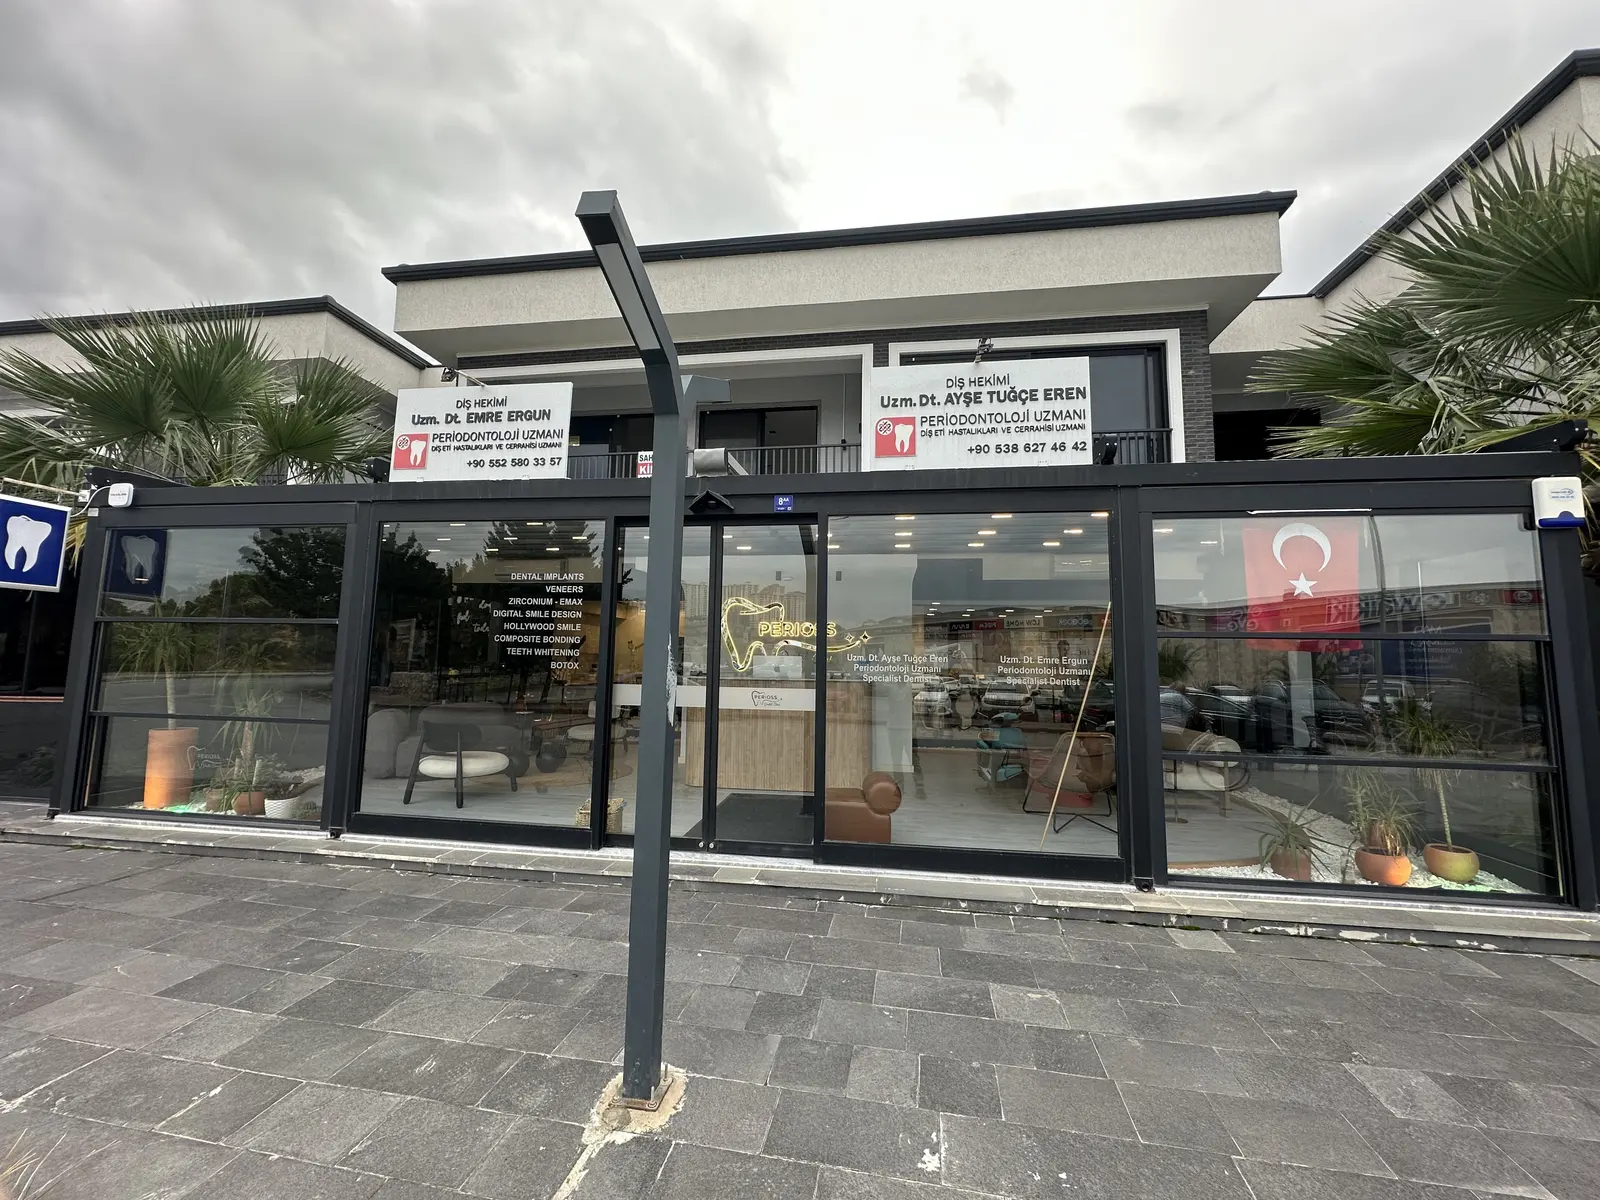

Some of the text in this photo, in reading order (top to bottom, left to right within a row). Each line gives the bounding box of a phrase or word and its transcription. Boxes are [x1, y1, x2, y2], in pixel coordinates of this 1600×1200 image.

[946, 374, 1010, 390] DİŞ HEKİMİ
[456, 396, 507, 410] DİŞ HEKİMİ
[880, 386, 1086, 408] Uzm. Dt. AYŞE TUĞÇE EREN
[412, 409, 550, 426] Uzm. Dt. EMRE ERGUN
[920, 409, 1086, 426] PERİODONTOLOJİ UZMANI
[432, 429, 563, 442] PERİODONTOLOJİ UZMANI
[920, 429, 933, 438] DİŞ
[934, 428, 945, 436] ETİ
[949, 427, 998, 436] HASTALIKLARI
[1014, 424, 1054, 433] CERRAHİSİ
[506, 442, 536, 450] CERRAHİSİ
[968, 442, 1087, 454] +90 538 627 46 42
[467, 457, 562, 468] +90 552 580 33 57
[758, 622, 837, 637] PERIOS
[847, 654, 866, 662] Uzm.
[869, 654, 879, 662] Dt.
[930, 654, 948, 662] Eren
[1000, 656, 1021, 664] Uzm.
[1058, 657, 1088, 666] Ergun
[854, 664, 910, 674] Periodontoloji
[998, 666, 1056, 676] Periodontoloji
[863, 674, 933, 683] Specialist Dentist
[1006, 676, 1080, 686] Specialist Dentist
